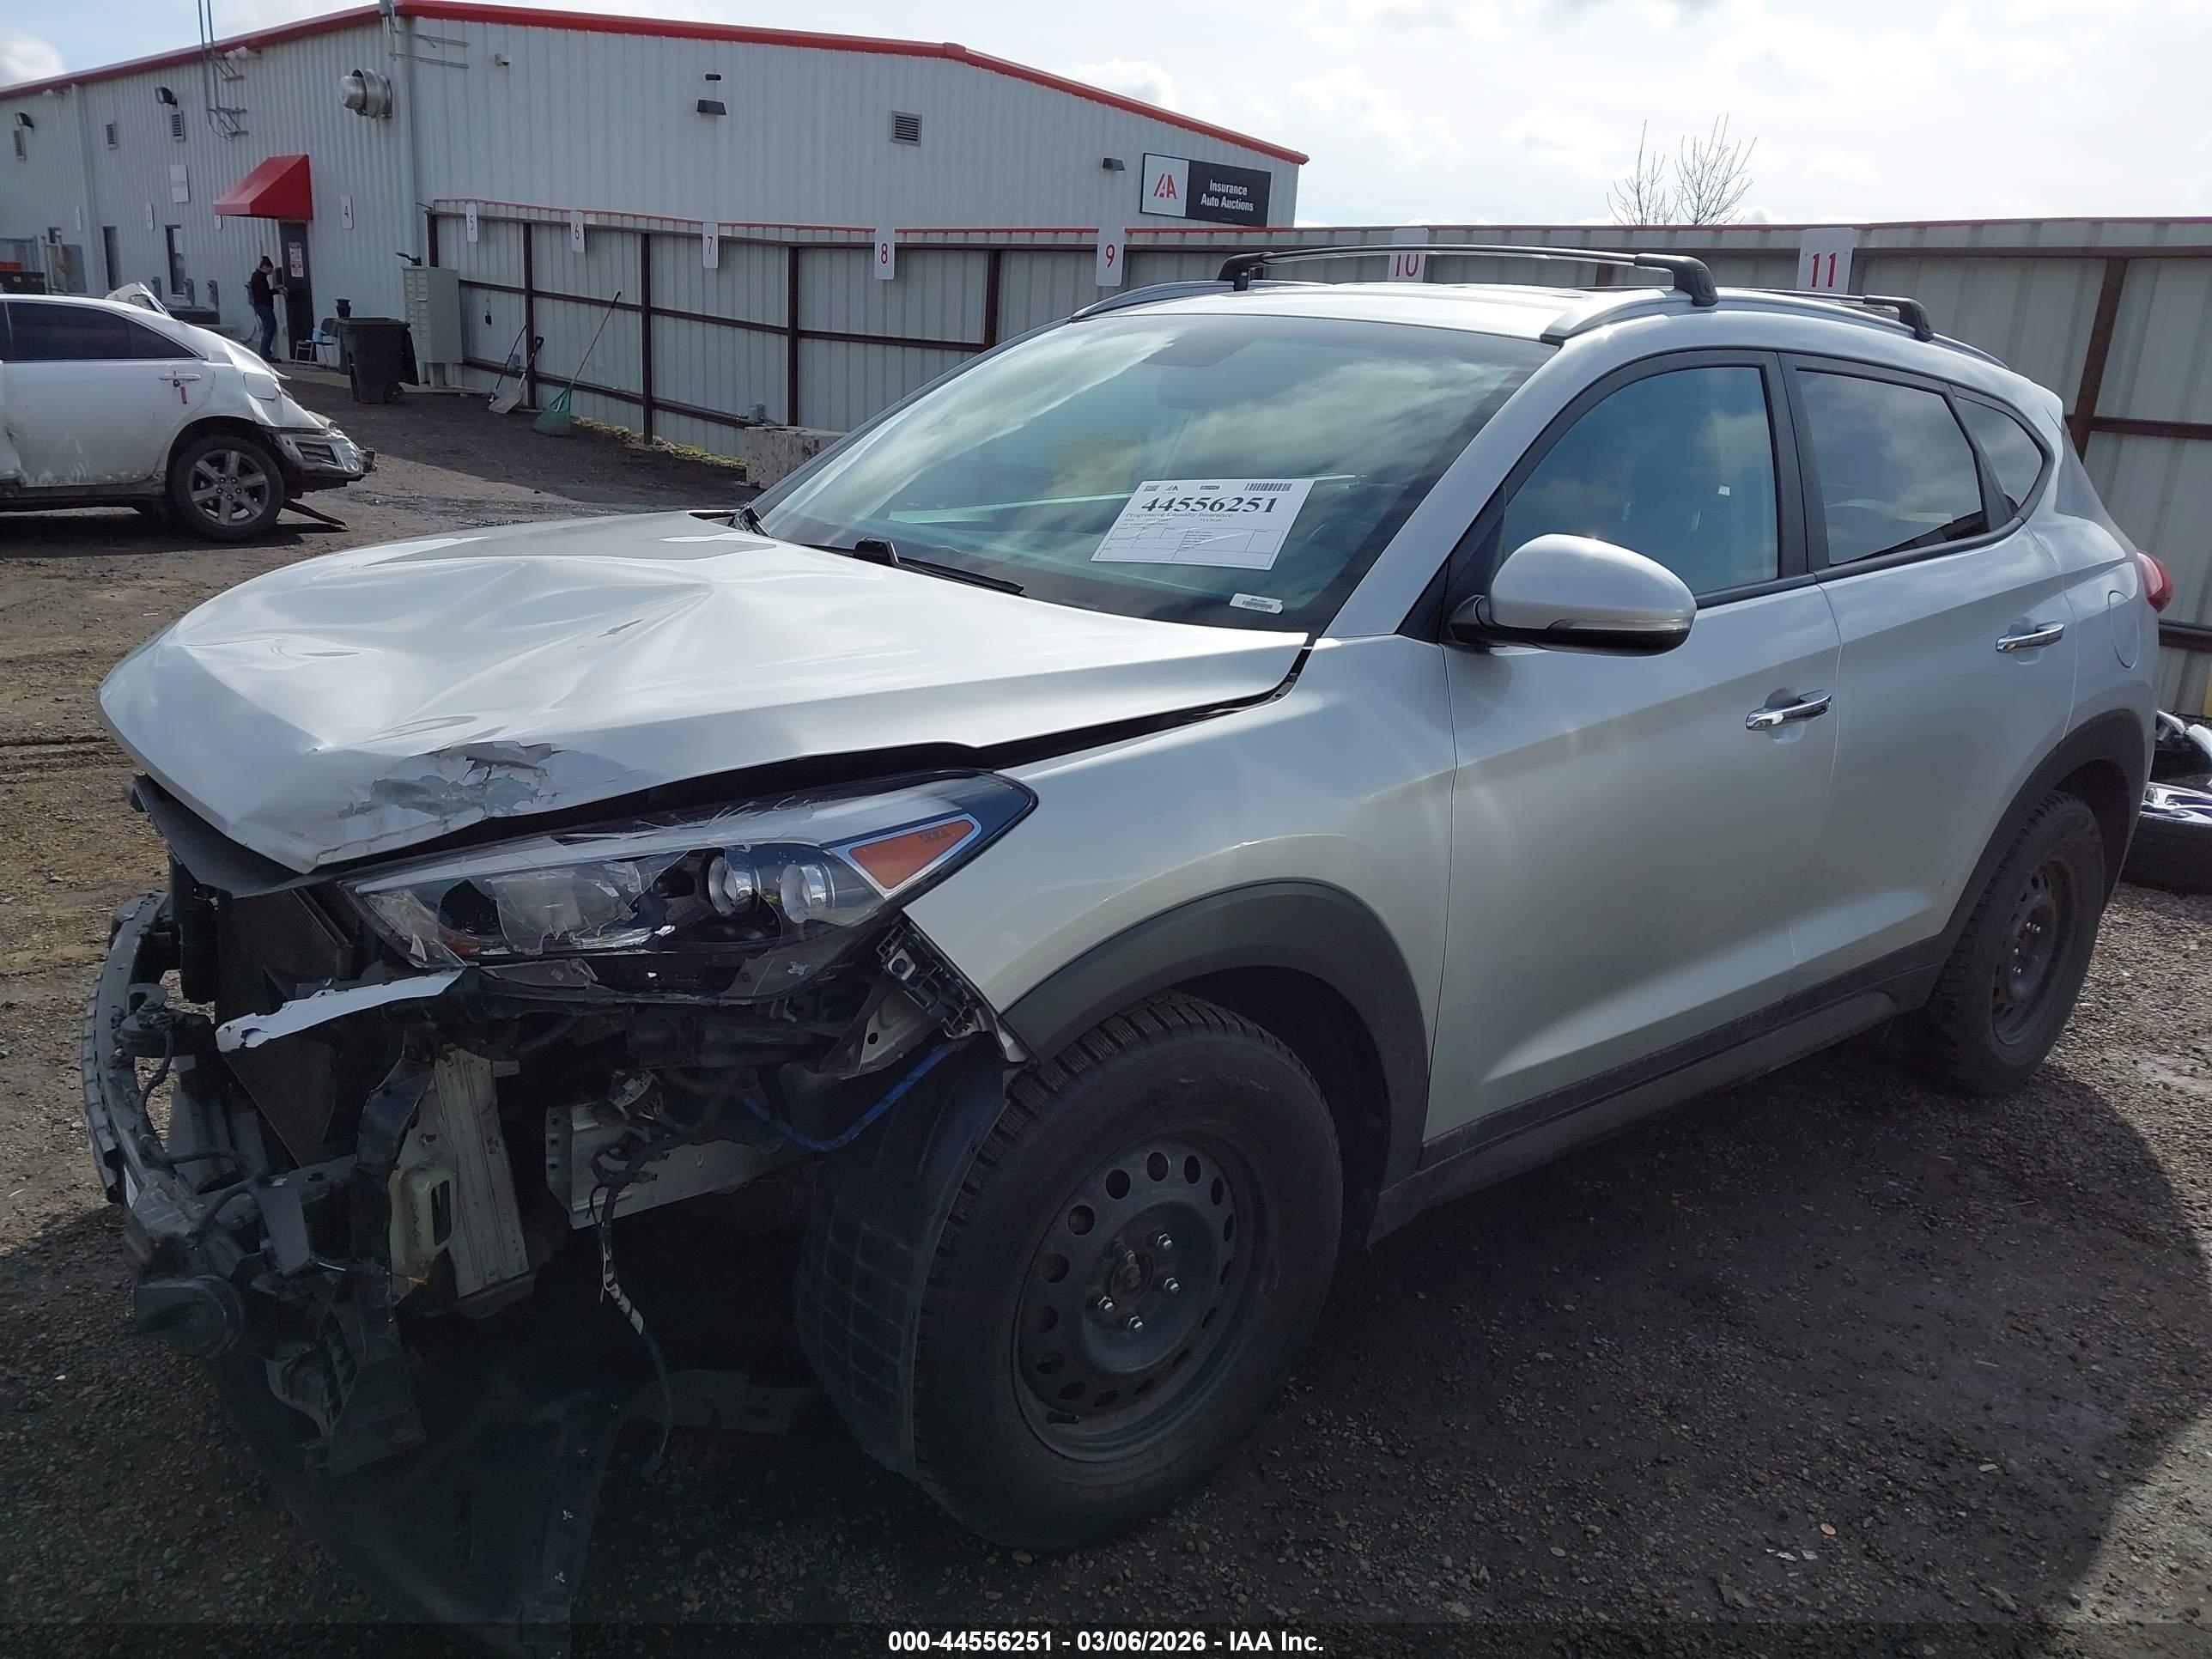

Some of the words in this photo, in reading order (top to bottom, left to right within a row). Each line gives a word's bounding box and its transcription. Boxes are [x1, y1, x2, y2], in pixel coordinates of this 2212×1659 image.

[1209, 179, 1248, 196] Insurance
[1200, 192, 1219, 207] Auto
[1220, 196, 1254, 211] Auctions
[343, 205, 349, 219] 4
[469, 215, 474, 231] 5
[574, 223, 580, 240] 6
[707, 235, 713, 255] 7
[881, 242, 888, 264] 8
[1105, 244, 1115, 269] 9
[1811, 252, 1837, 288] 11
[1140, 496, 1278, 513] 44556251
